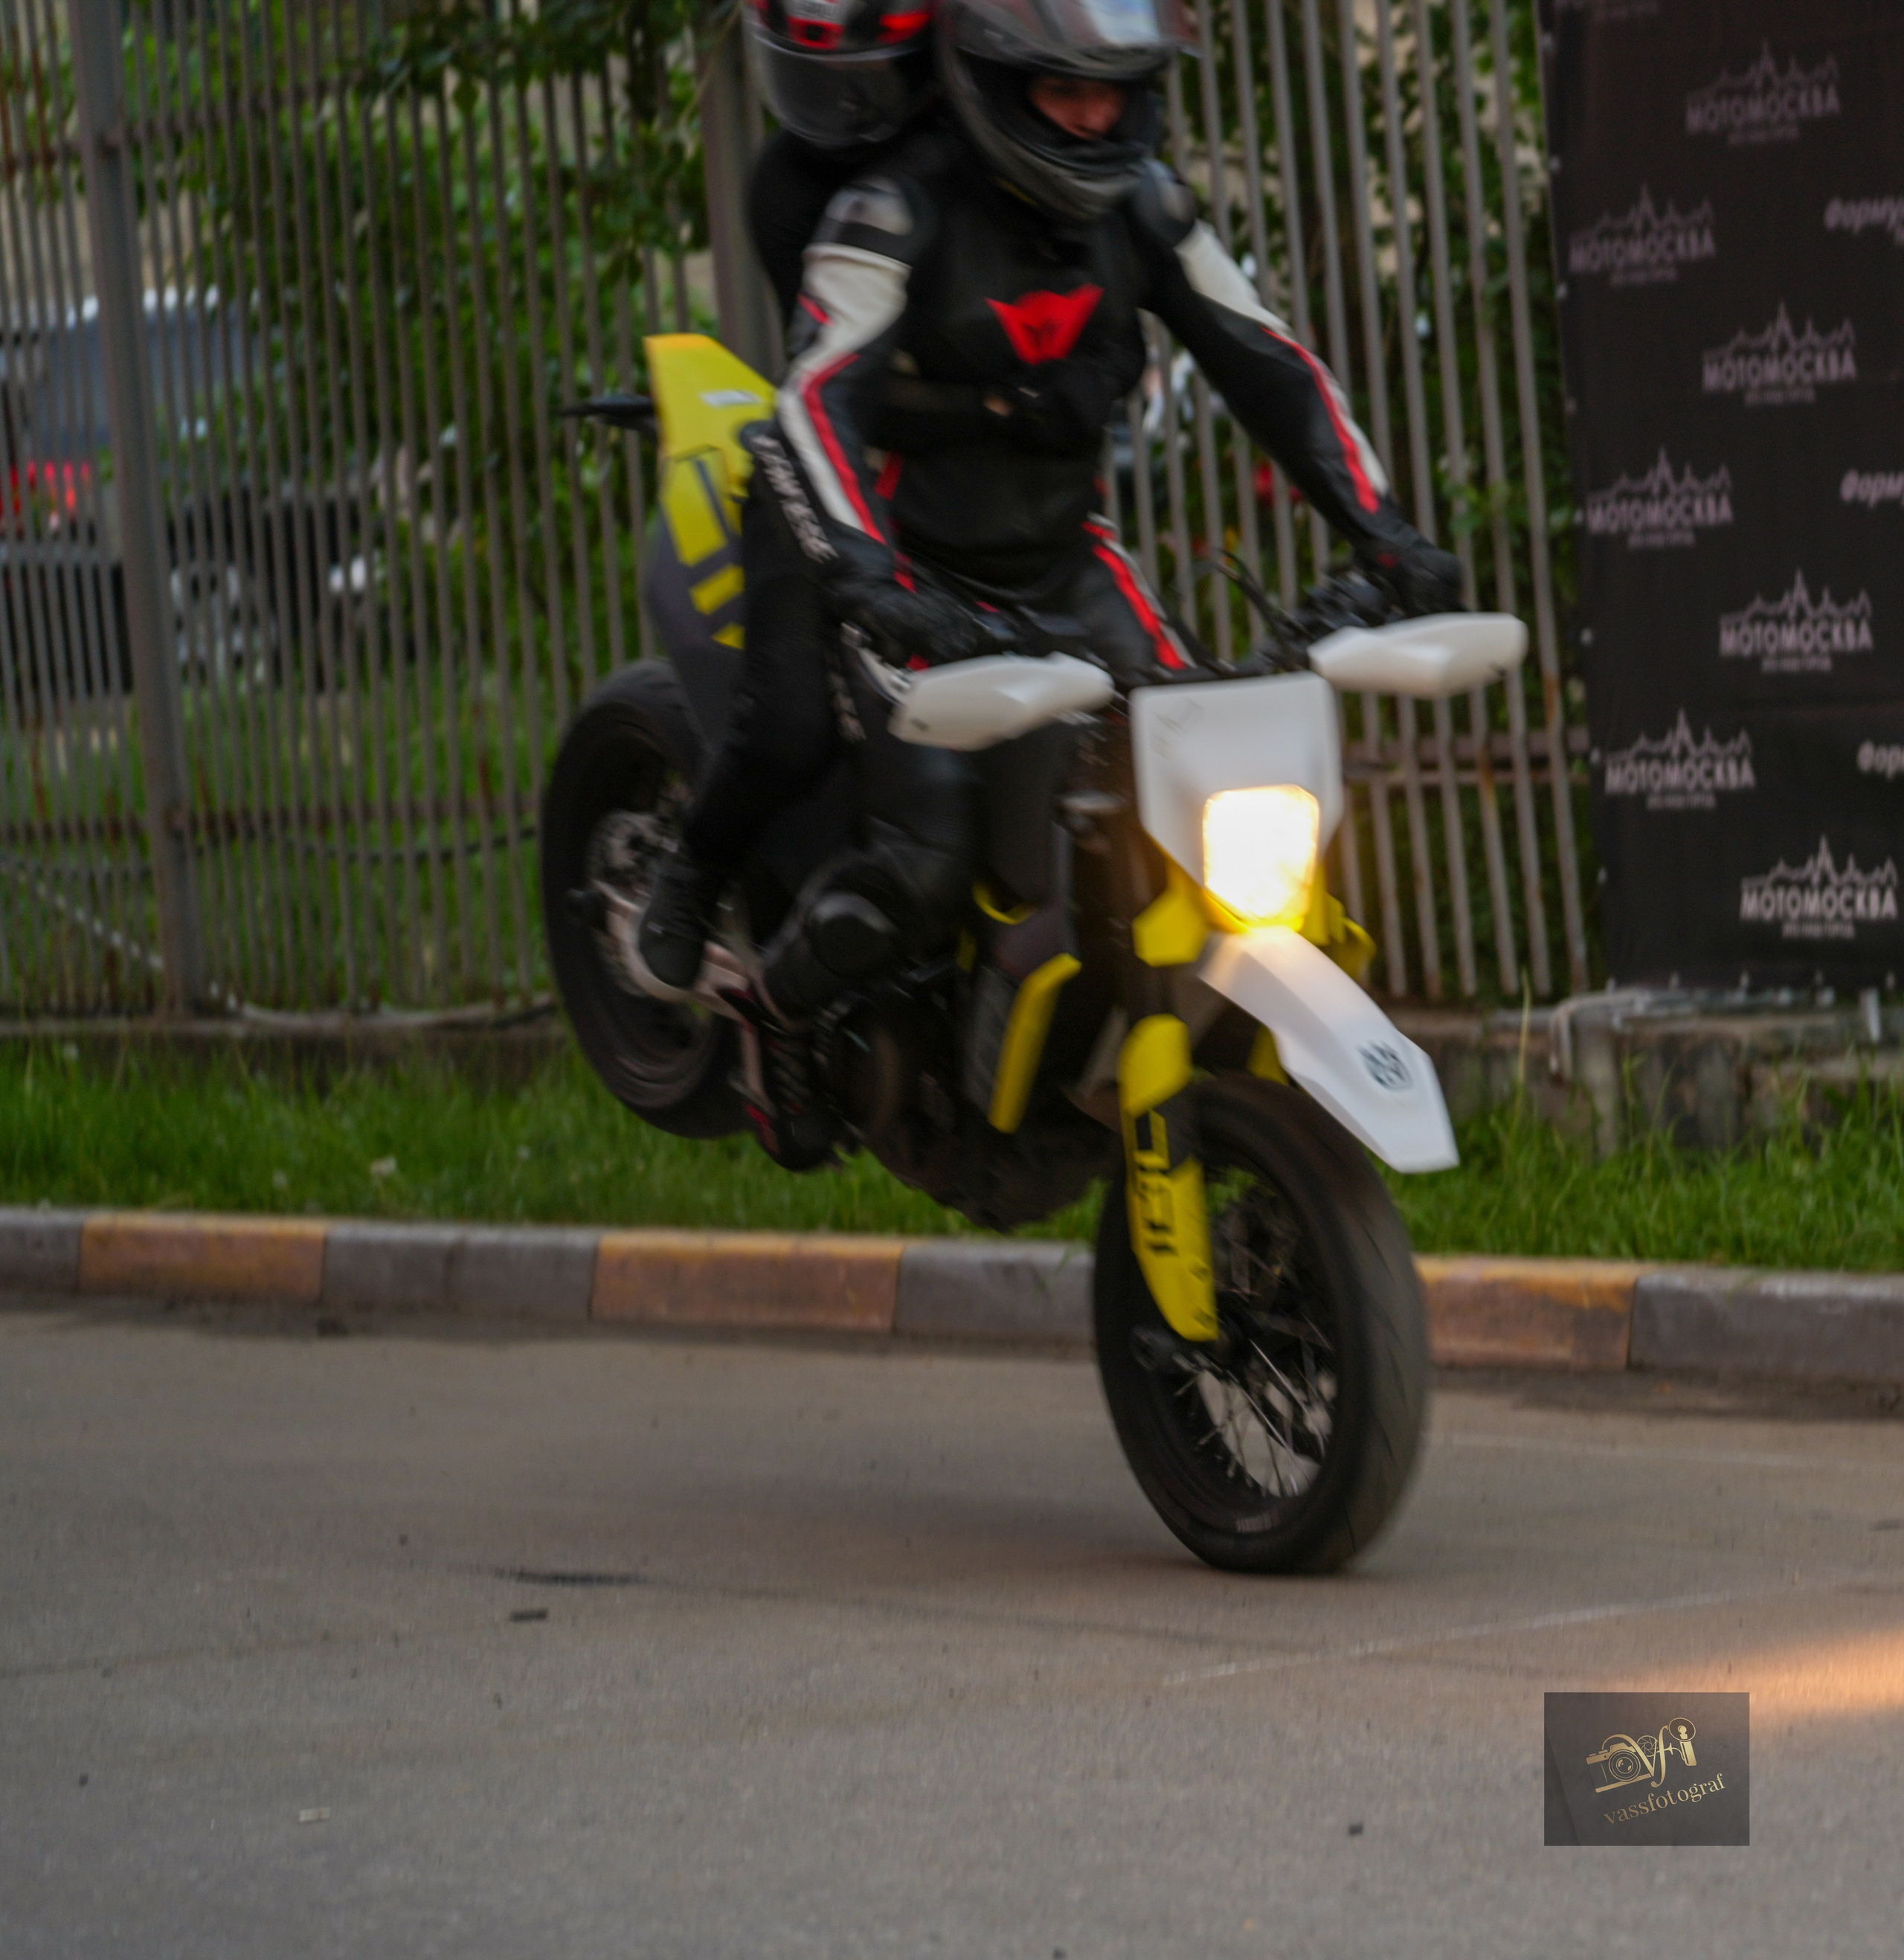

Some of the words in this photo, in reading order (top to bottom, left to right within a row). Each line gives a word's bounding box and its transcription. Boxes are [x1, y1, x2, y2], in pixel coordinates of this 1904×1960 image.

[1703, 347, 1856, 393] МОТОМОСКВА
[1587, 495, 1734, 533] МОТОМОСКВА
[1719, 619, 1873, 658] МОТОМОСКВА
[1605, 757, 1755, 794] МОТОМОСКВА
[1740, 886, 1897, 921] МОТОМОСКВА
